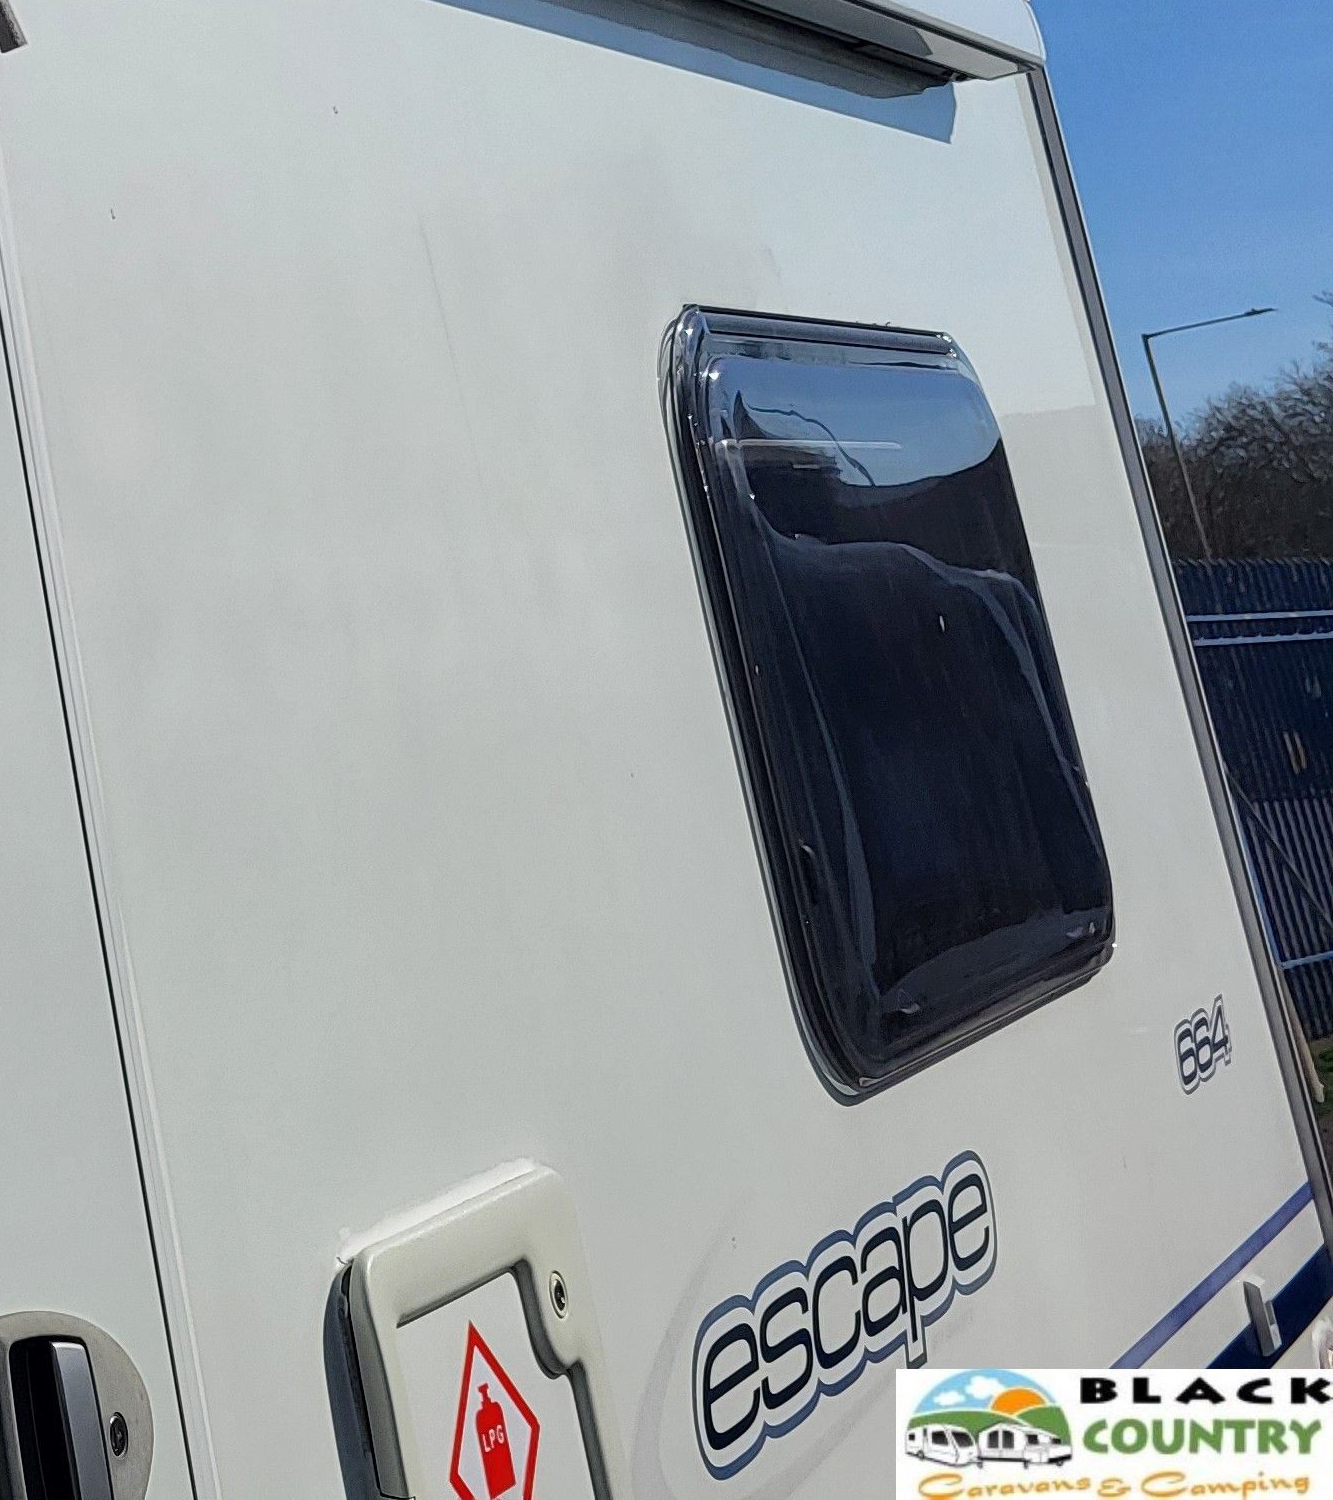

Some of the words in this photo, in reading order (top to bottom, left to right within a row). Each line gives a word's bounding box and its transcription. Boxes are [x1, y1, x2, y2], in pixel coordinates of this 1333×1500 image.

[1175, 998, 1231, 1091] 664
[697, 1160, 993, 1465] escape
[482, 1424, 505, 1453] LPG
